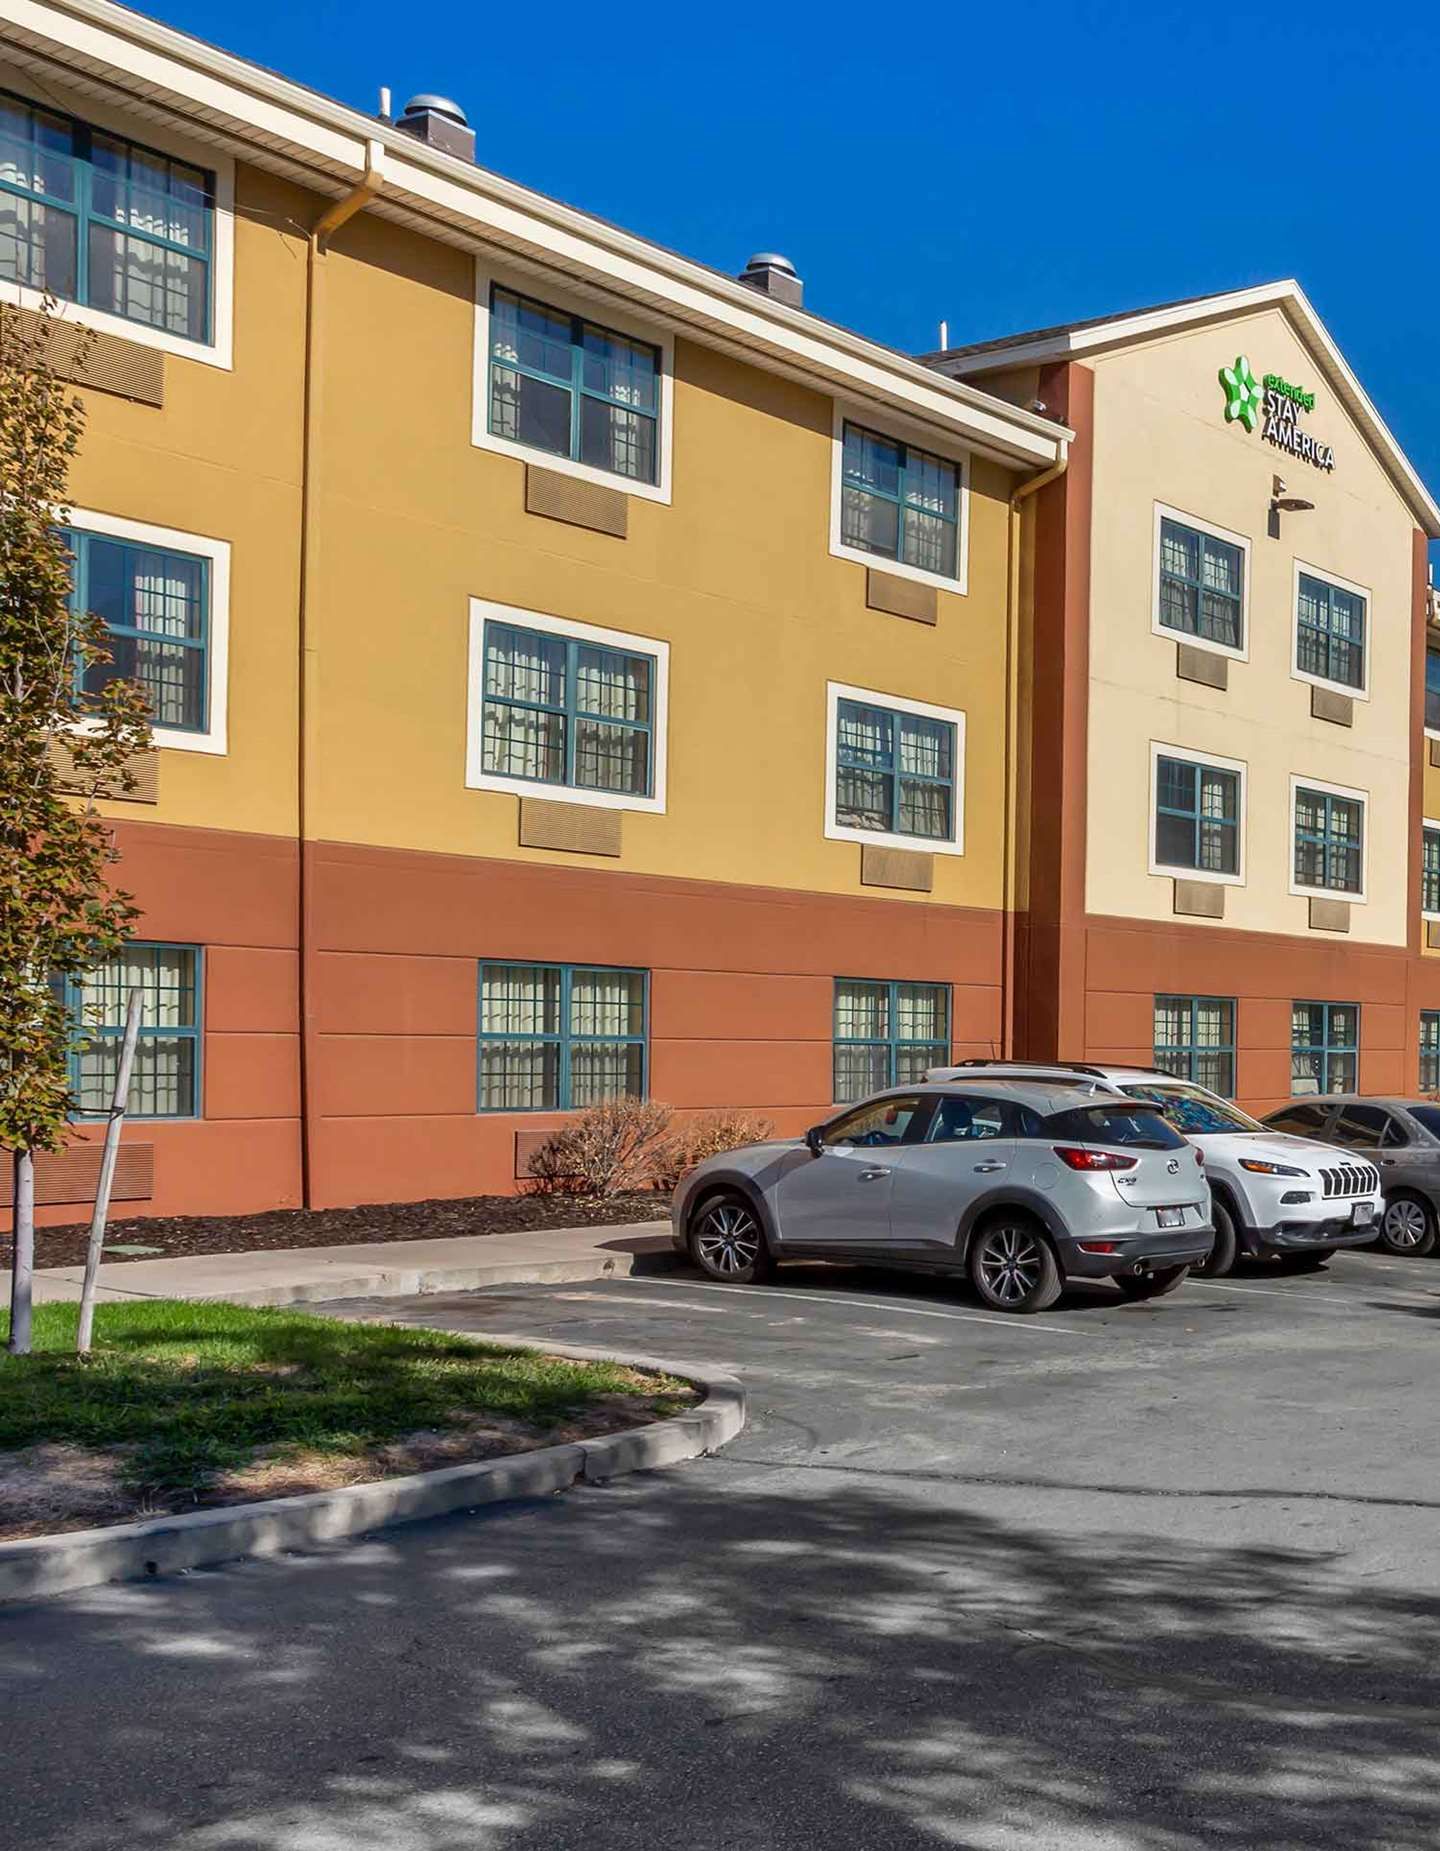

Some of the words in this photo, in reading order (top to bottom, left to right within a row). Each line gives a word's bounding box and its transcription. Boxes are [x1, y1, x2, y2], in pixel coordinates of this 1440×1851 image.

[1265, 374, 1315, 410] extended
[1267, 390, 1303, 425] STAY
[1266, 416, 1336, 470] AMERICA
